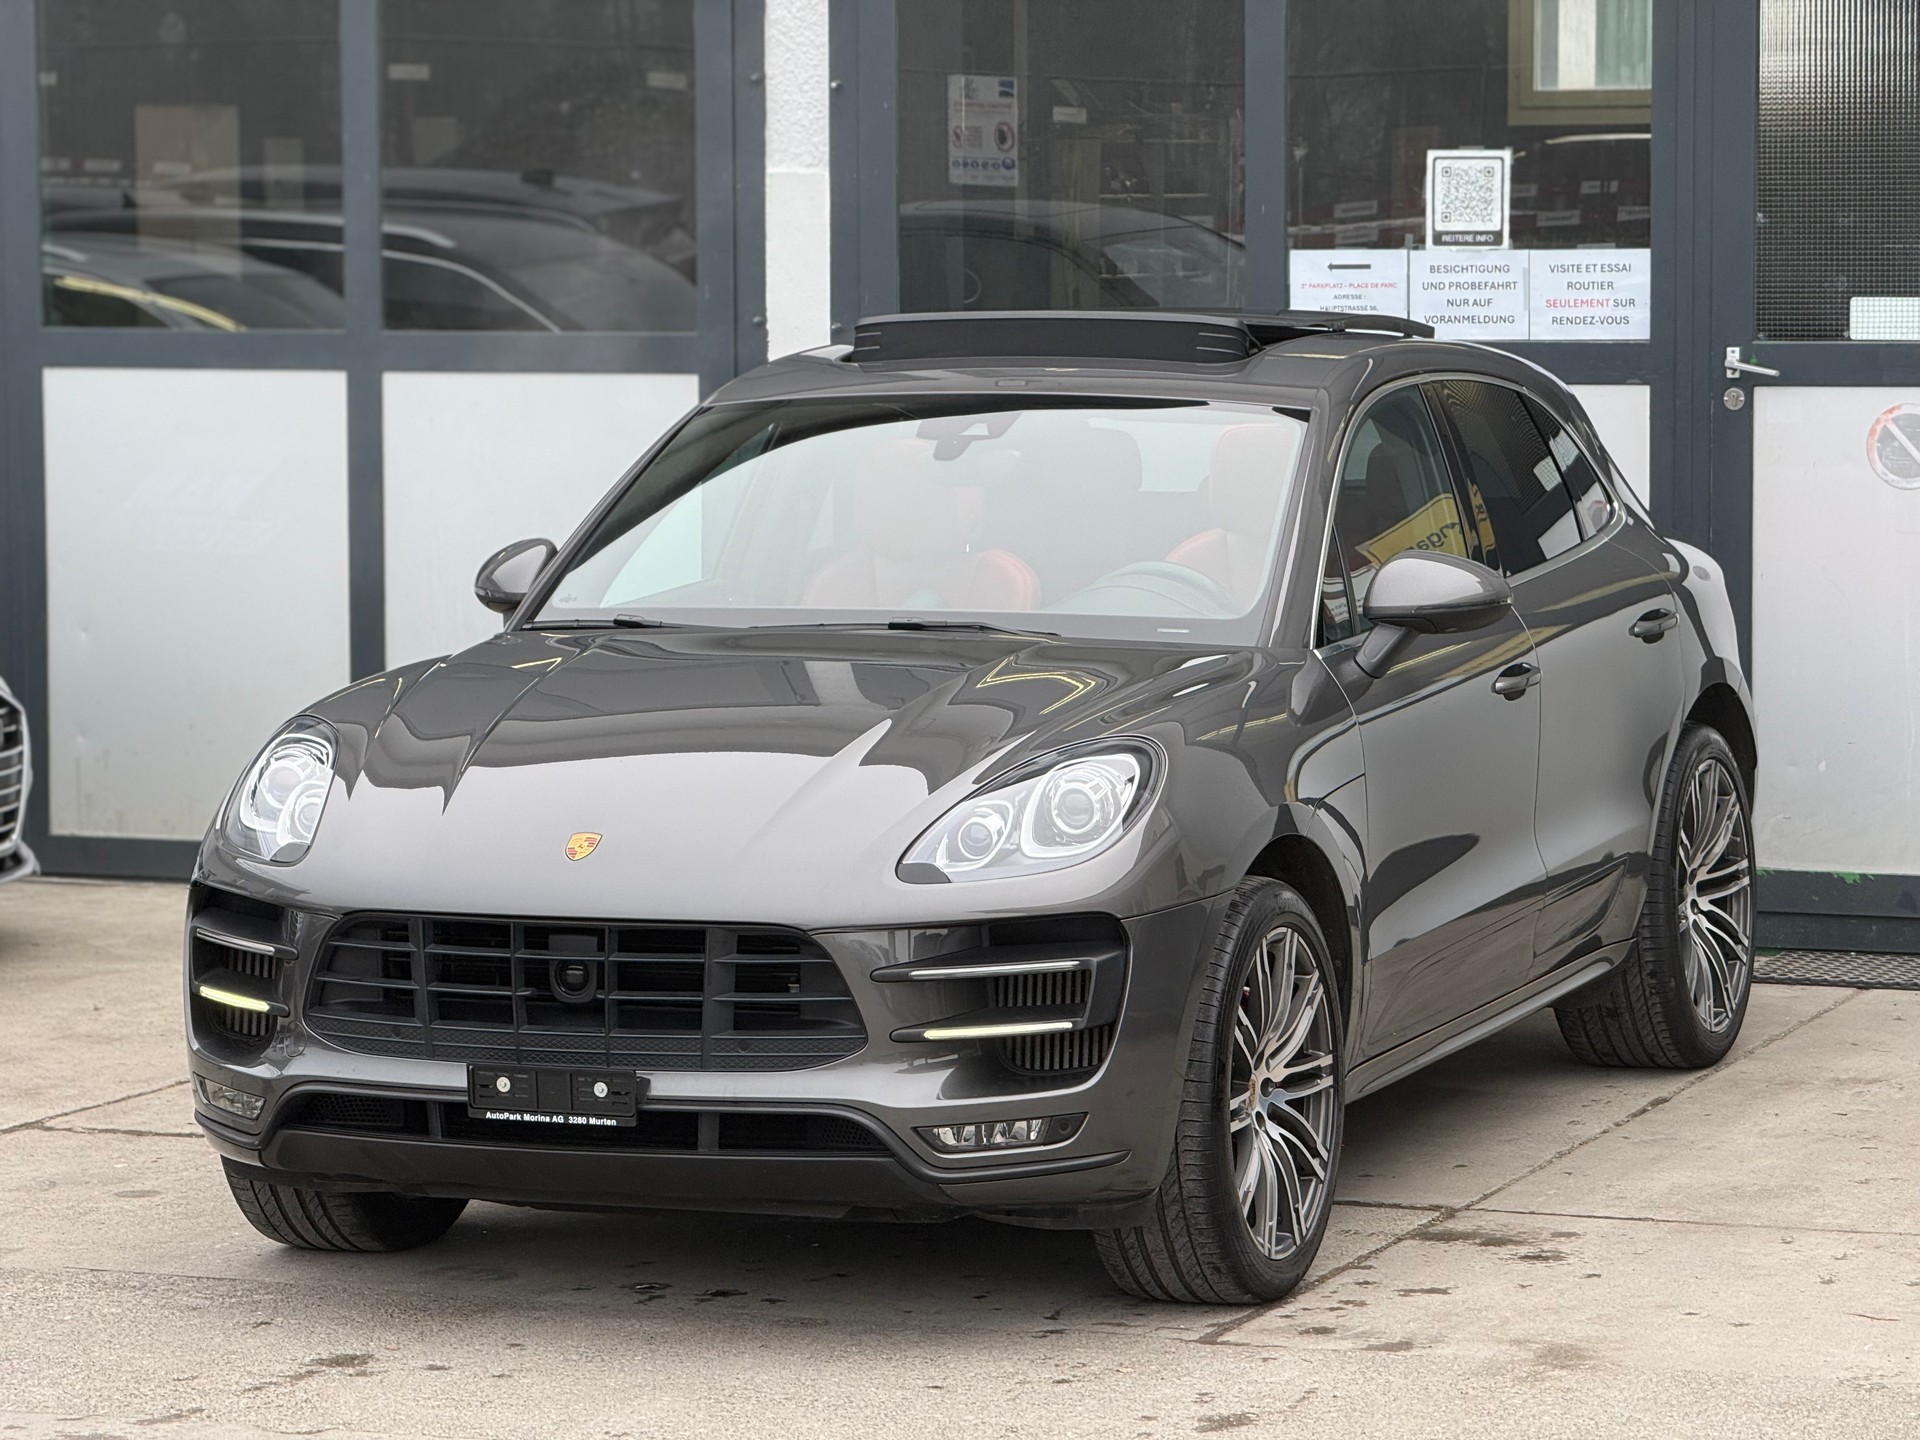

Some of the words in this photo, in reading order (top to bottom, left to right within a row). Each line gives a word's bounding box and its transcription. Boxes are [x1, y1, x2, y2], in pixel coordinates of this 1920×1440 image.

[1442, 234, 1474, 242] WEITERE
[1476, 234, 1494, 242] INFO
[1429, 264, 1510, 273] BESICHTIGUNG
[1549, 263, 1582, 273] VISITE
[1585, 263, 1597, 273] ET
[1600, 263, 1631, 273] ESSAI
[1422, 281, 1446, 291] UND
[1448, 281, 1518, 290] PROBEFAHRT
[1567, 281, 1614, 290] ROUTIER
[1446, 298, 1470, 307] NUR
[1471, 298, 1493, 307] AUF
[1545, 298, 1610, 308] SEULEMENT
[1613, 298, 1636, 307] SUR
[1424, 314, 1515, 324] VORANMELDUNG
[1551, 316, 1630, 325] RENDEZ-VOUS
[485, 1111, 521, 1121] AutoPark
[523, 1113, 550, 1123] Morina
[551, 1115, 564, 1123] AG
[568, 1116, 587, 1125] 3280
[589, 1117, 617, 1126] Murten
